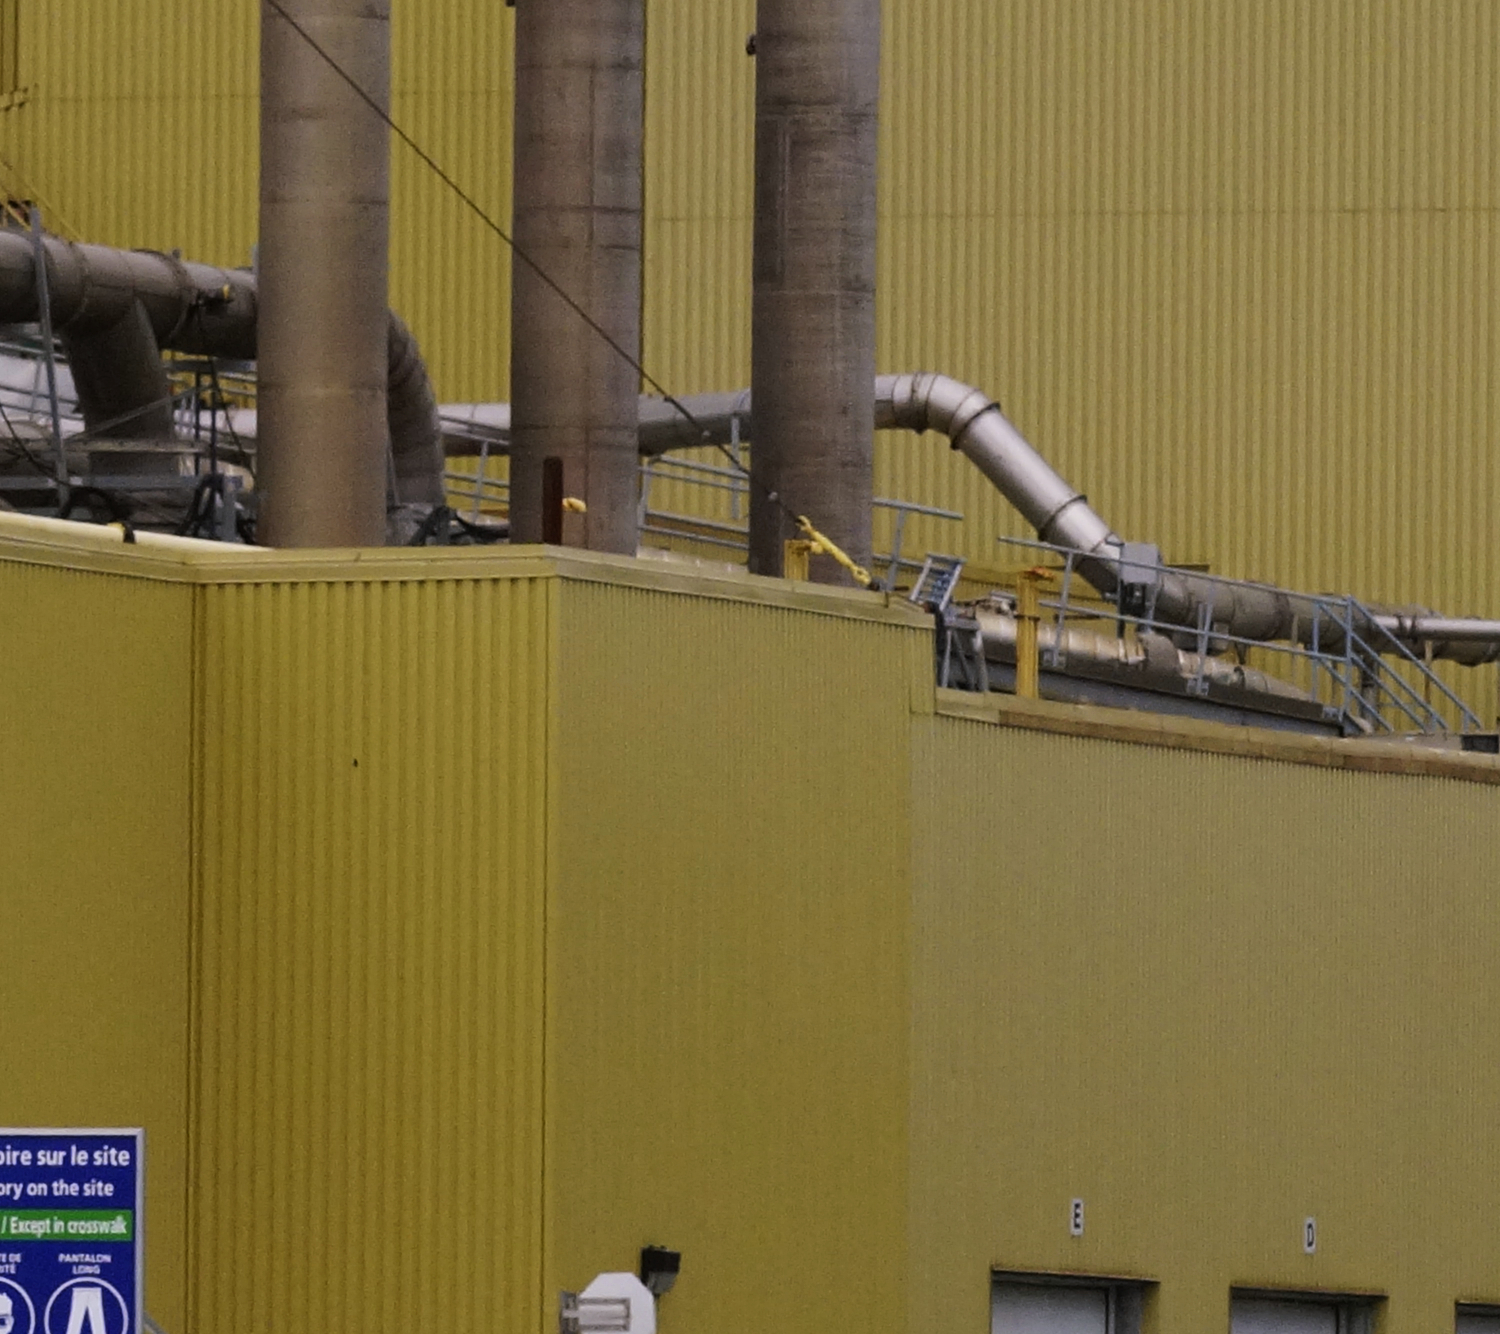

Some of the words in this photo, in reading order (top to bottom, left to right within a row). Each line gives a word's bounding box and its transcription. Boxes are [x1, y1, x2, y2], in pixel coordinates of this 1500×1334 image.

[37, 1149, 66, 1166] sur
[71, 1145, 88, 1166] le
[93, 1145, 130, 1167] site
[27, 1183, 48, 1196] on
[52, 1180, 79, 1196] the
[83, 1179, 114, 1196] site
[10, 1216, 50, 1238] Except
[54, 1216, 65, 1234] in
[67, 1216, 127, 1235] crosswalk
[1073, 1203, 1081, 1229] E
[1307, 1223, 1315, 1248] D
[58, 1253, 112, 1263] PANTALON
